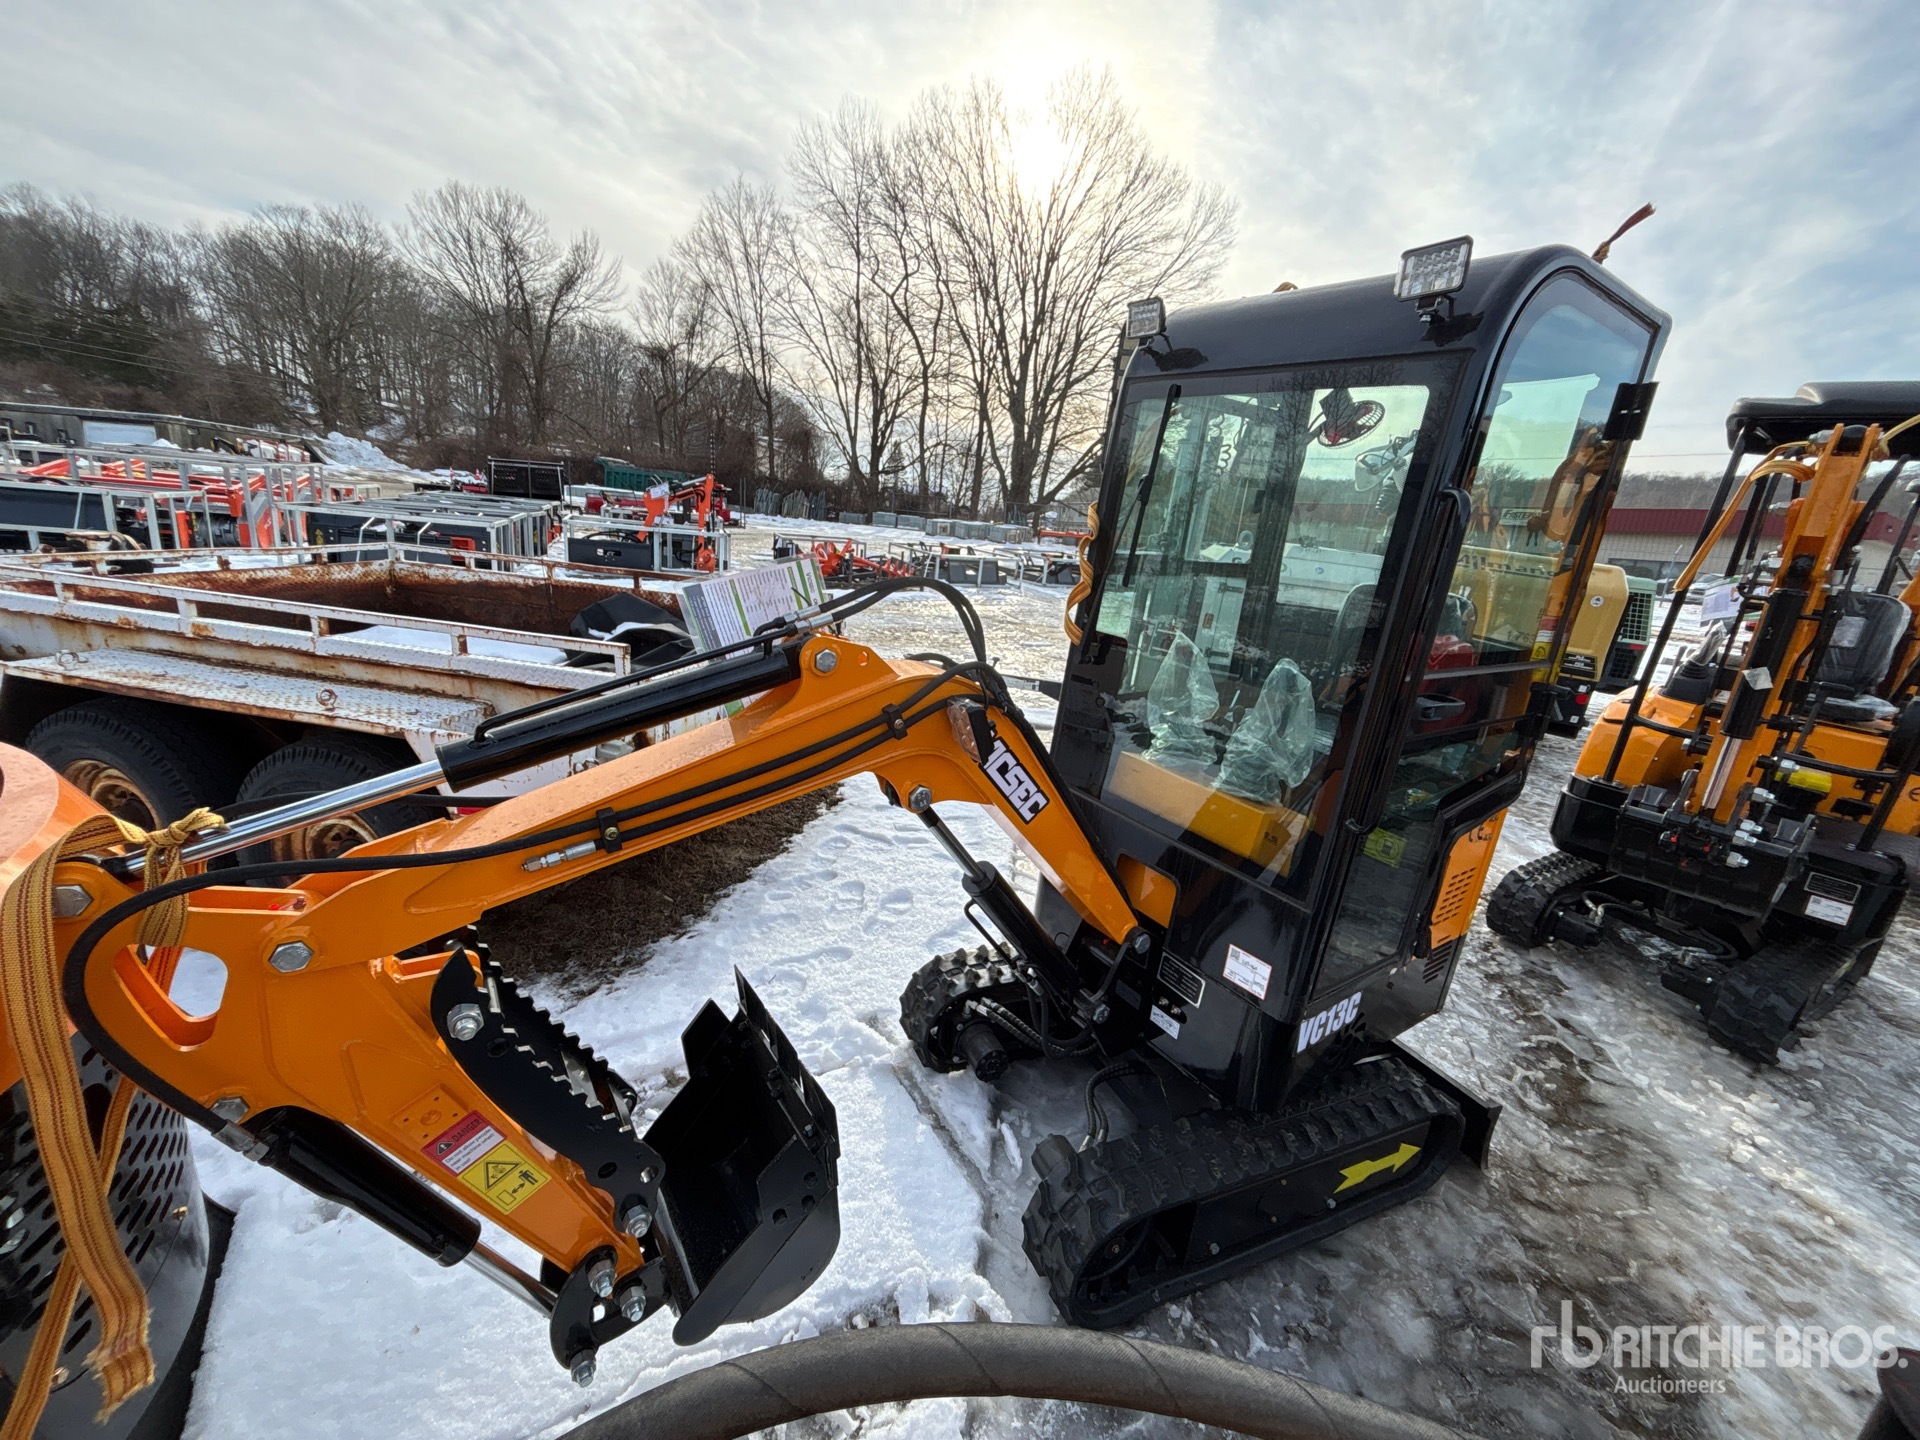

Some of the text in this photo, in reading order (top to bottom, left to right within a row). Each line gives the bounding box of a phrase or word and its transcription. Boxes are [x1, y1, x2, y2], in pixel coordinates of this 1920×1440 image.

[983, 735, 1049, 822] ICSEC
[1297, 991, 1363, 1053] VC13C
[451, 1118, 482, 1142] DANGER
[462, 1140, 476, 1152] allow
[474, 1128, 492, 1143] people
[450, 1133, 495, 1167] near machine when
